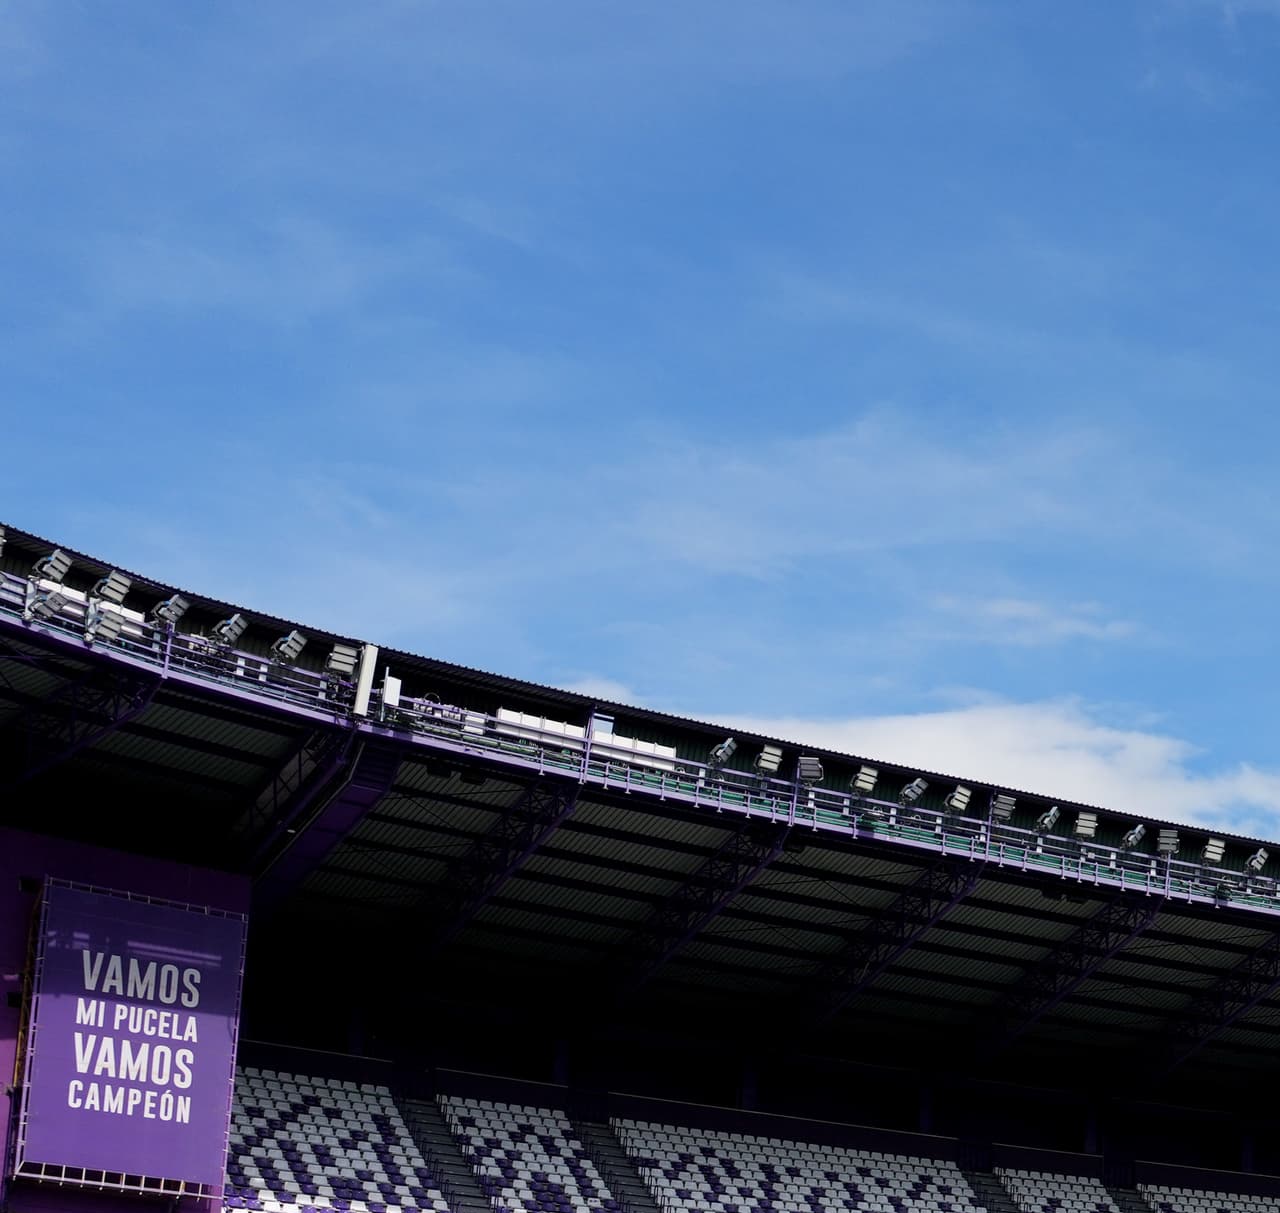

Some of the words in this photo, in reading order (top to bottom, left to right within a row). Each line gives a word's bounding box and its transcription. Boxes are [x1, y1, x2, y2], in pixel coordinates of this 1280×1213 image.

[82, 949, 201, 1008] VAMOS
[76, 998, 104, 1027] MI
[114, 1004, 198, 1043] PUCELA
[74, 1032, 194, 1089] VAMOS
[68, 1079, 191, 1124] CAMPEÓN
